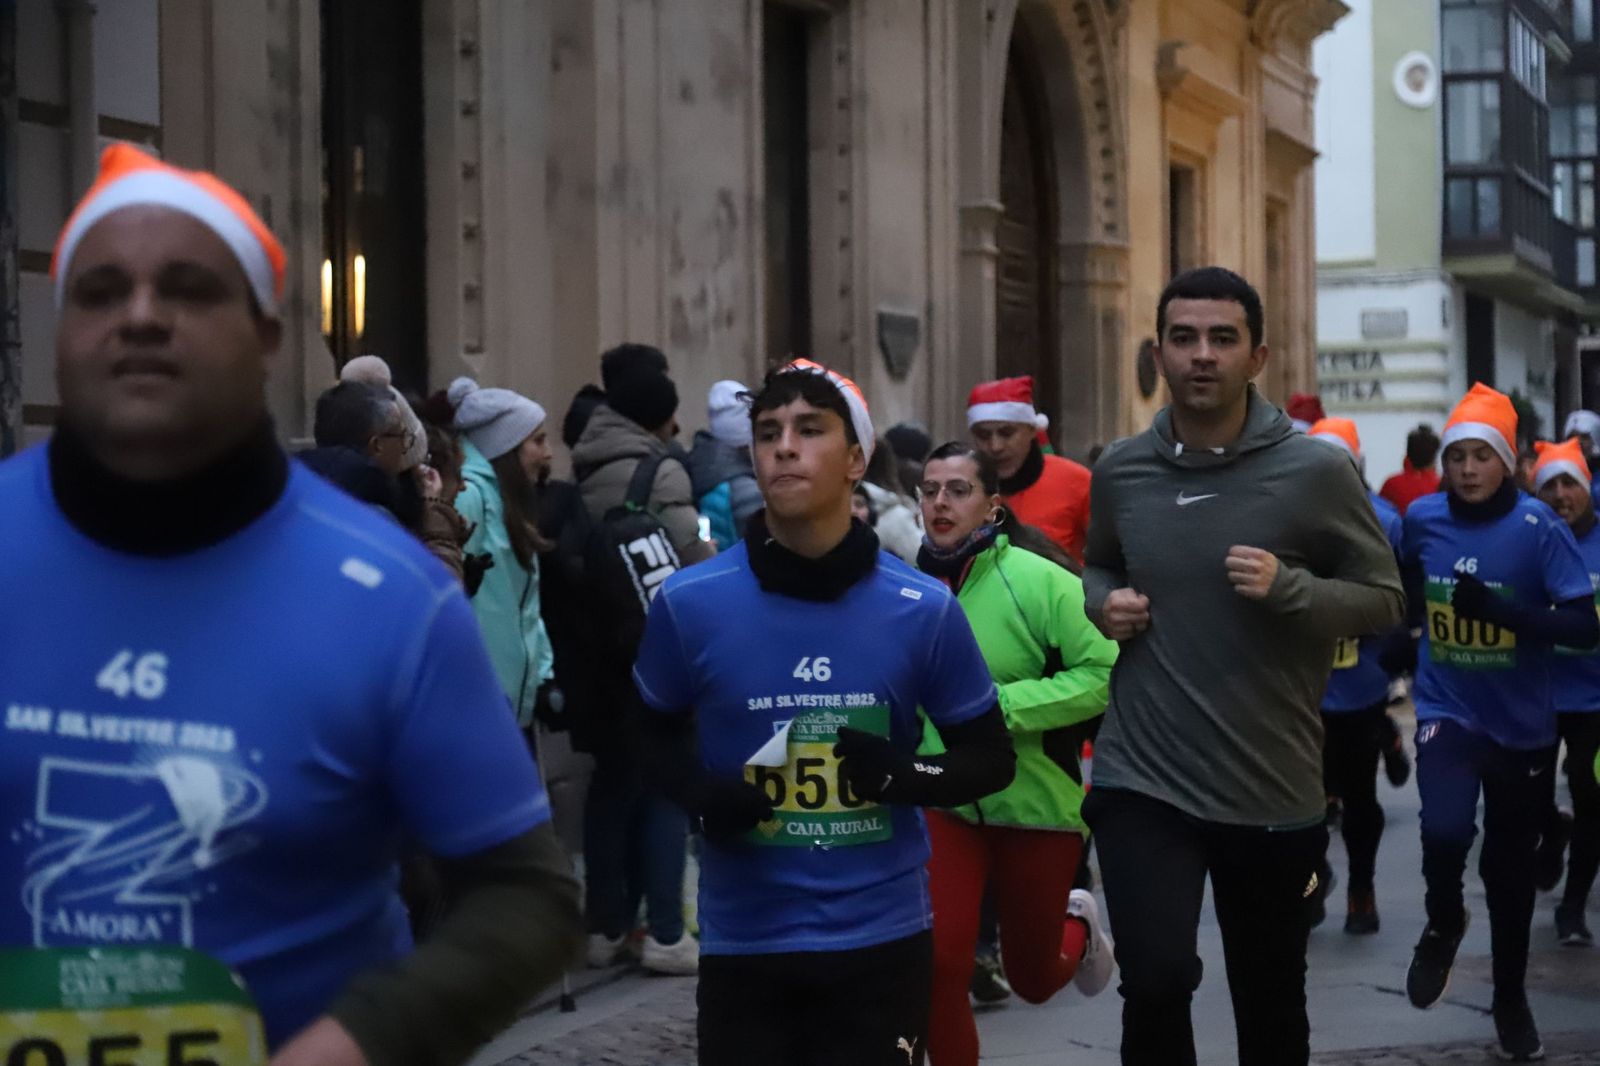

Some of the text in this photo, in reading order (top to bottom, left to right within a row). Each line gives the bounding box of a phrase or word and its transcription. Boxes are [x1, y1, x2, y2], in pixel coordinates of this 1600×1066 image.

[1454, 557, 1478, 574] 46
[96, 648, 168, 698] 46
[793, 656, 832, 682] 46
[748, 692, 877, 710] SAN SILVESTRE 2025
[786, 816, 884, 836] CAJA RURAL
